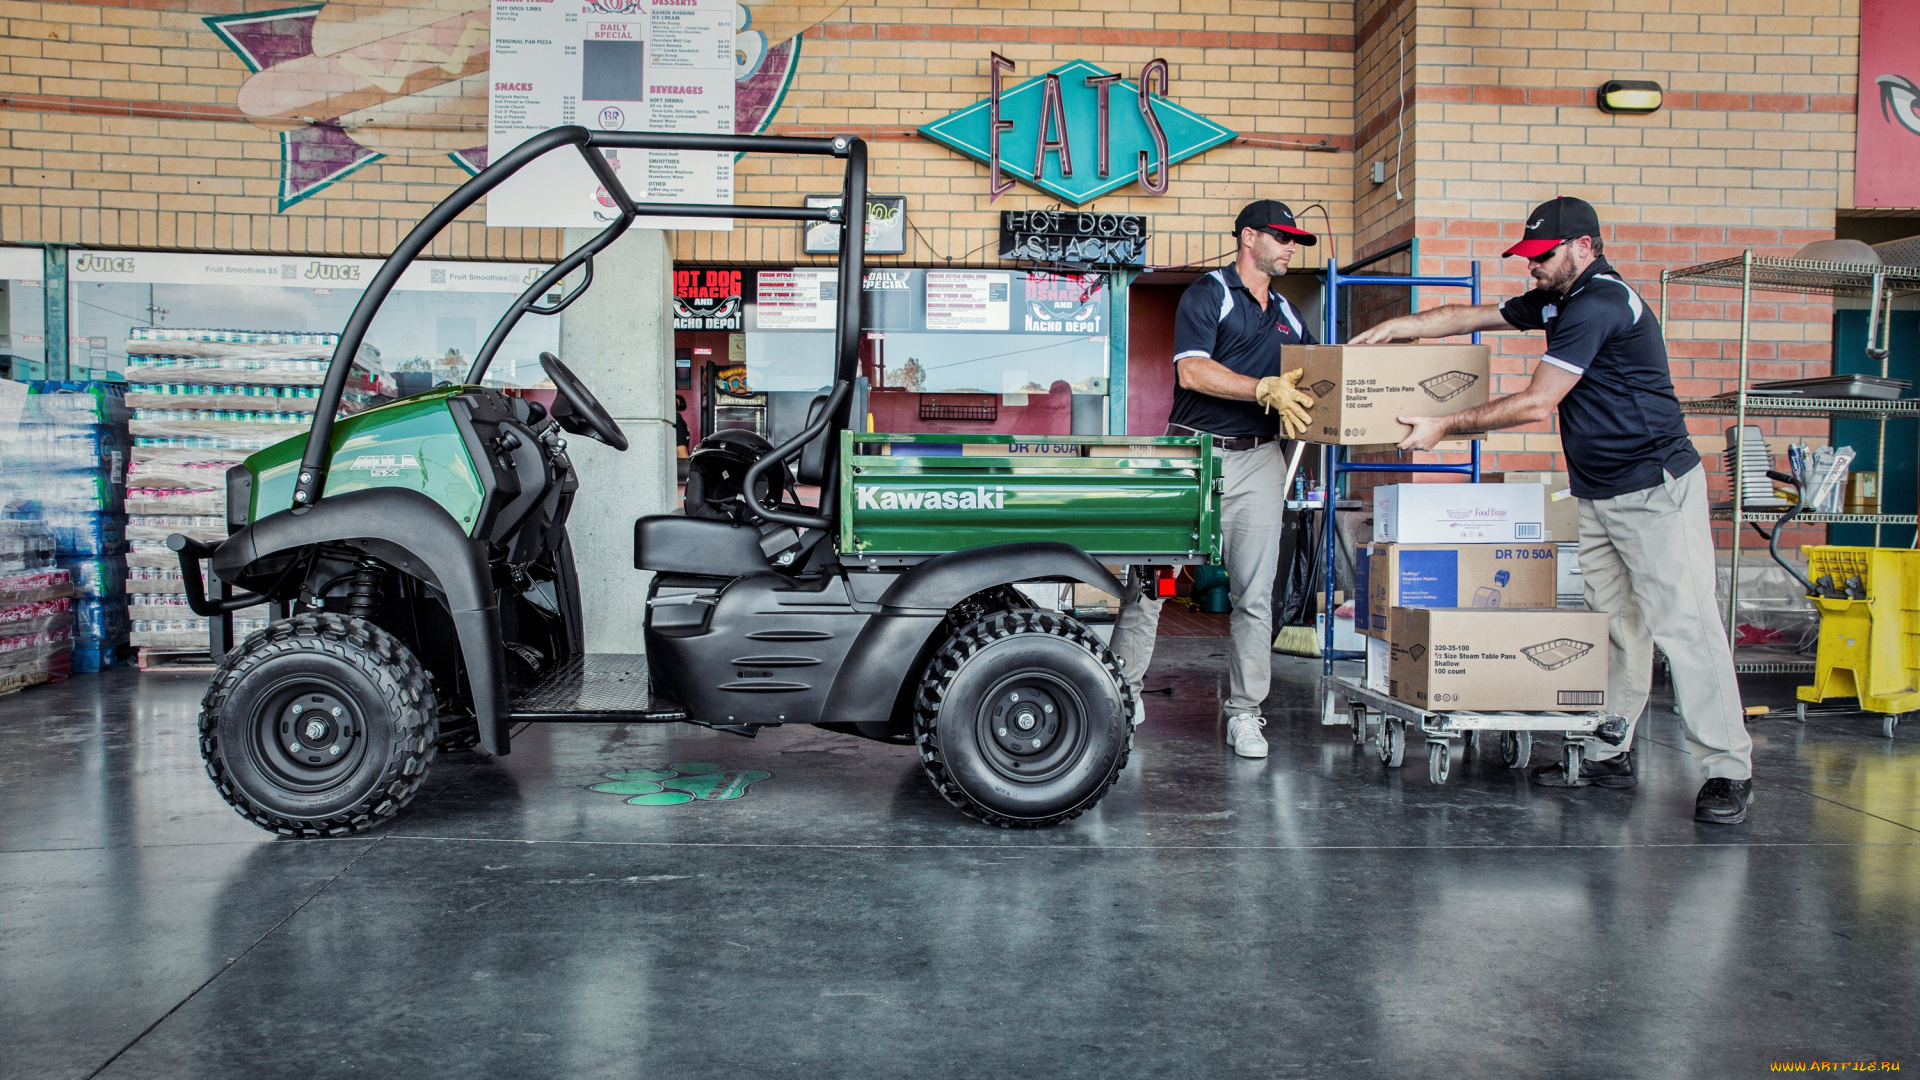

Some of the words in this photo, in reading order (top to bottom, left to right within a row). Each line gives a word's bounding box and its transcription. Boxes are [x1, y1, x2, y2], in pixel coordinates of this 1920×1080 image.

[495, 82, 533, 91] SNACKS
[650, 85, 703, 94] BEVERAGES
[990, 50, 1169, 205] EATS
[1007, 210, 1065, 232] HOT
[1078, 212, 1140, 238] DOG
[1027, 235, 1122, 262] SHACK
[76, 253, 135, 273] JUICE
[205, 265, 224, 274] Fruit
[225, 265, 267, 274] Smoothies
[268, 267, 278, 275] $5
[304, 261, 360, 280] JUICE
[449, 273, 468, 281] Fruit
[469, 273, 508, 282] Smoothies
[868, 272, 897, 281] DAILY
[706, 270, 742, 298] DOG
[679, 287, 731, 299] SHACK
[694, 298, 714, 306] AND
[1053, 301, 1073, 309] AND
[674, 318, 703, 329] ACHO
[705, 311, 742, 329] DEPOT
[1025, 314, 1062, 332] NACHO
[1065, 315, 1101, 333] DEPOT
[349, 454, 421, 470] MULE
[857, 485, 1004, 510] Kawasaki
[1475, 508, 1490, 516] Food
[1491, 508, 1507, 518] Trays
[1495, 549, 1512, 559] DR
[1516, 549, 1529, 559] 70
[1532, 549, 1554, 559] 50A
